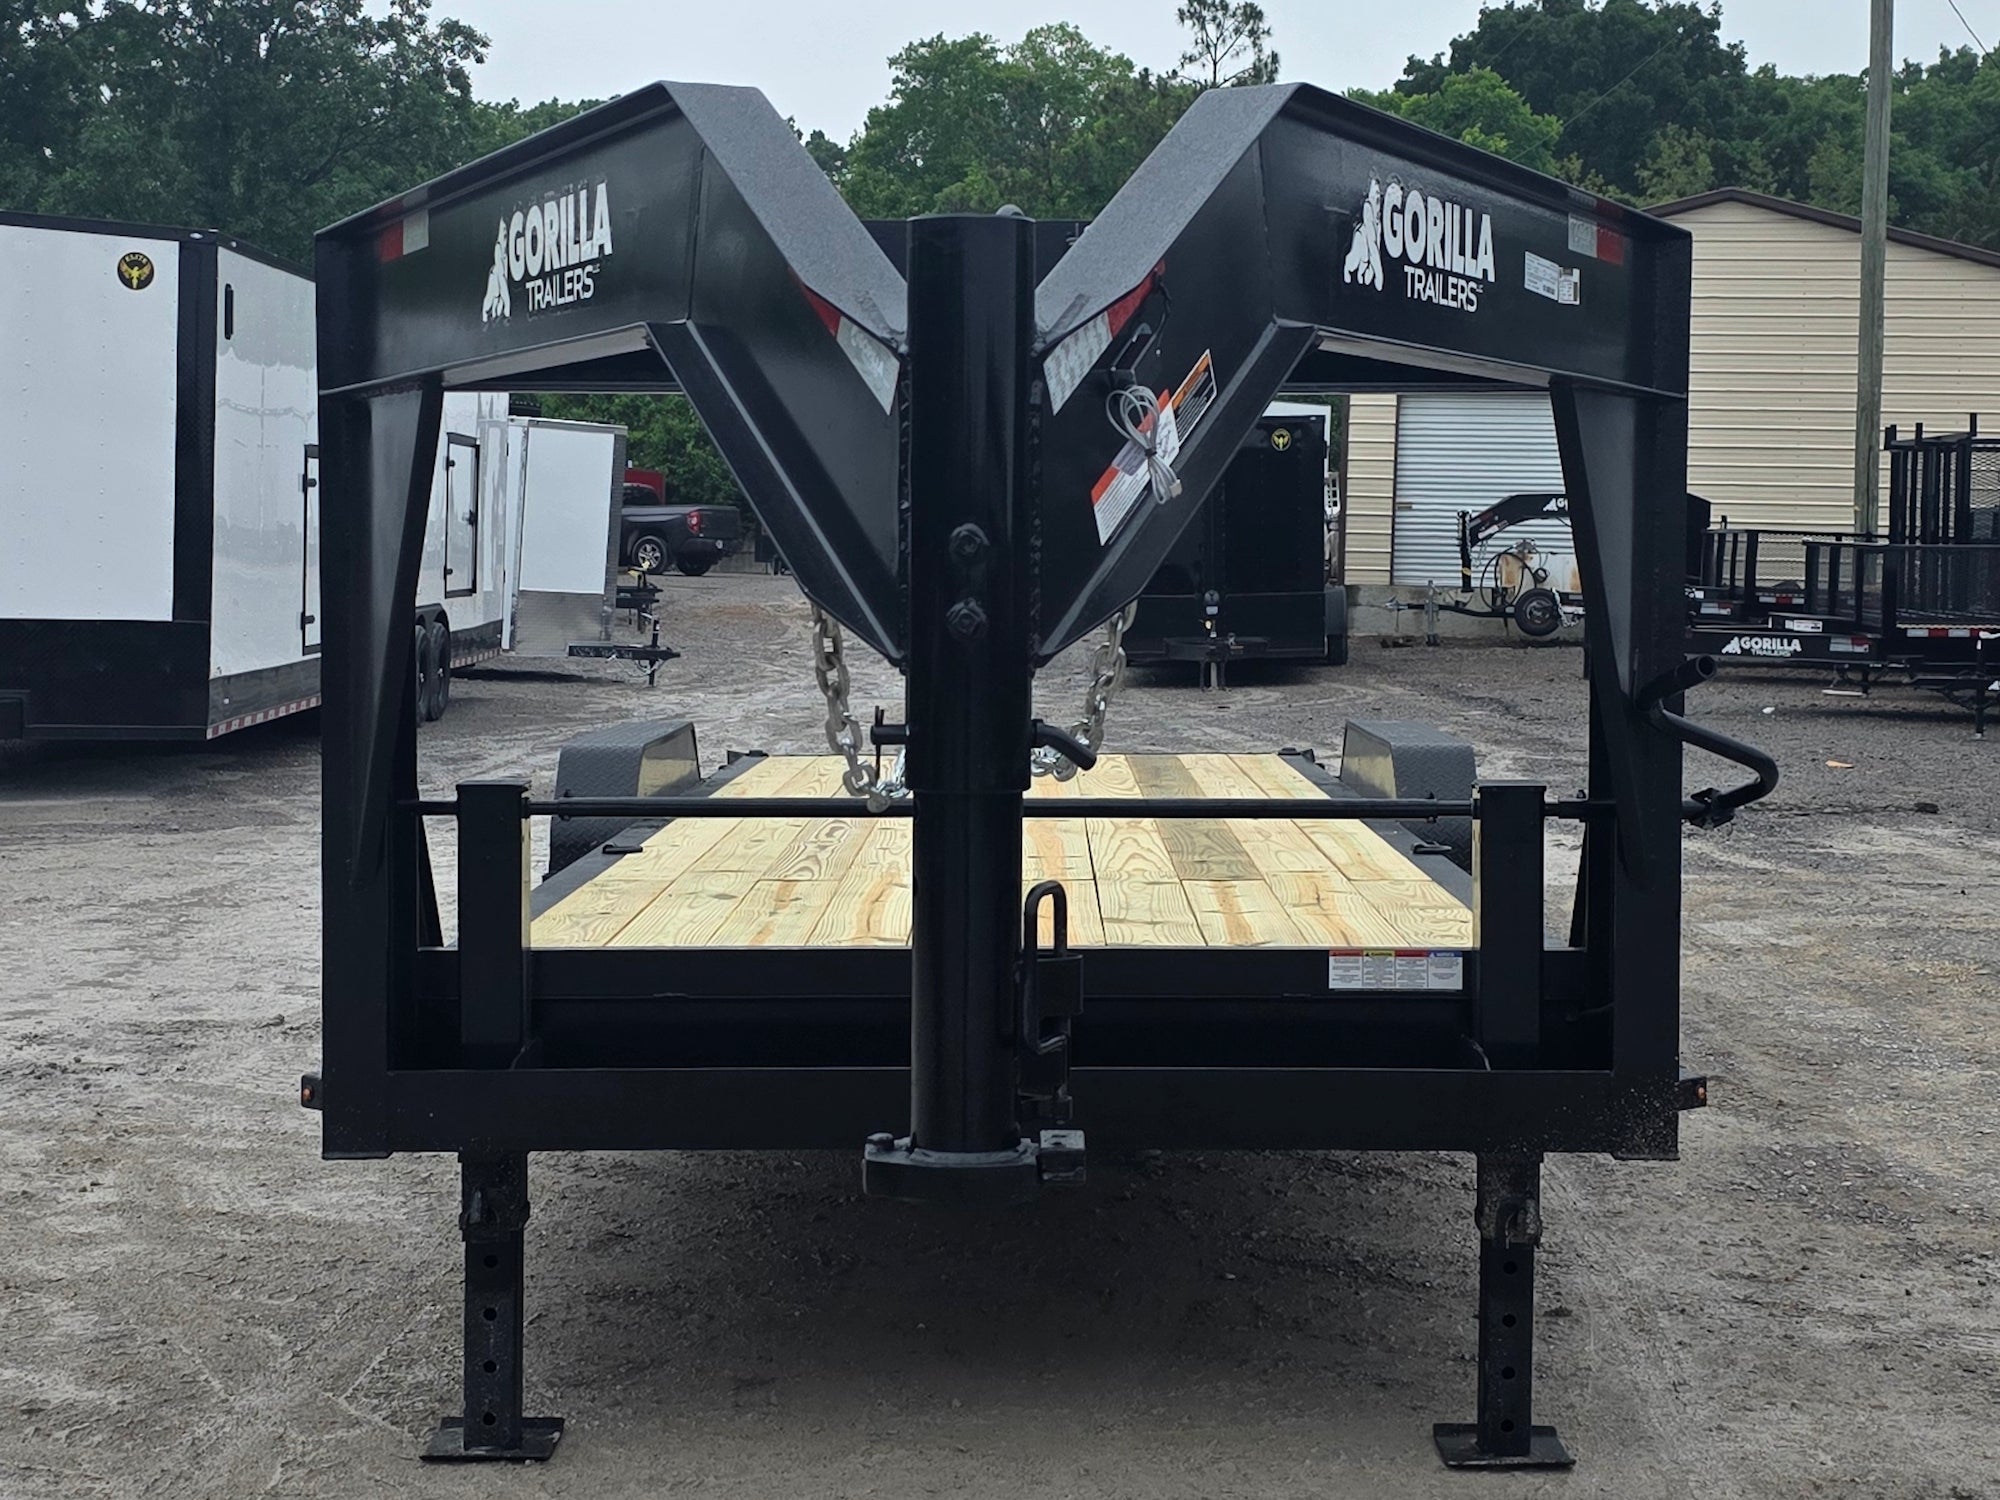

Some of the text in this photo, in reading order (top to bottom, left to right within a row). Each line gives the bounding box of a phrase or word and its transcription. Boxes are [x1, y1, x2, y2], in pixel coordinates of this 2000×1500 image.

[509, 182, 612, 281] GORILLA
[1383, 182, 1496, 283] GORILLA
[525, 264, 595, 312] TRAILERS
[1404, 264, 1478, 313] TRAILERS
[1740, 637, 1801, 651] GORILLA
